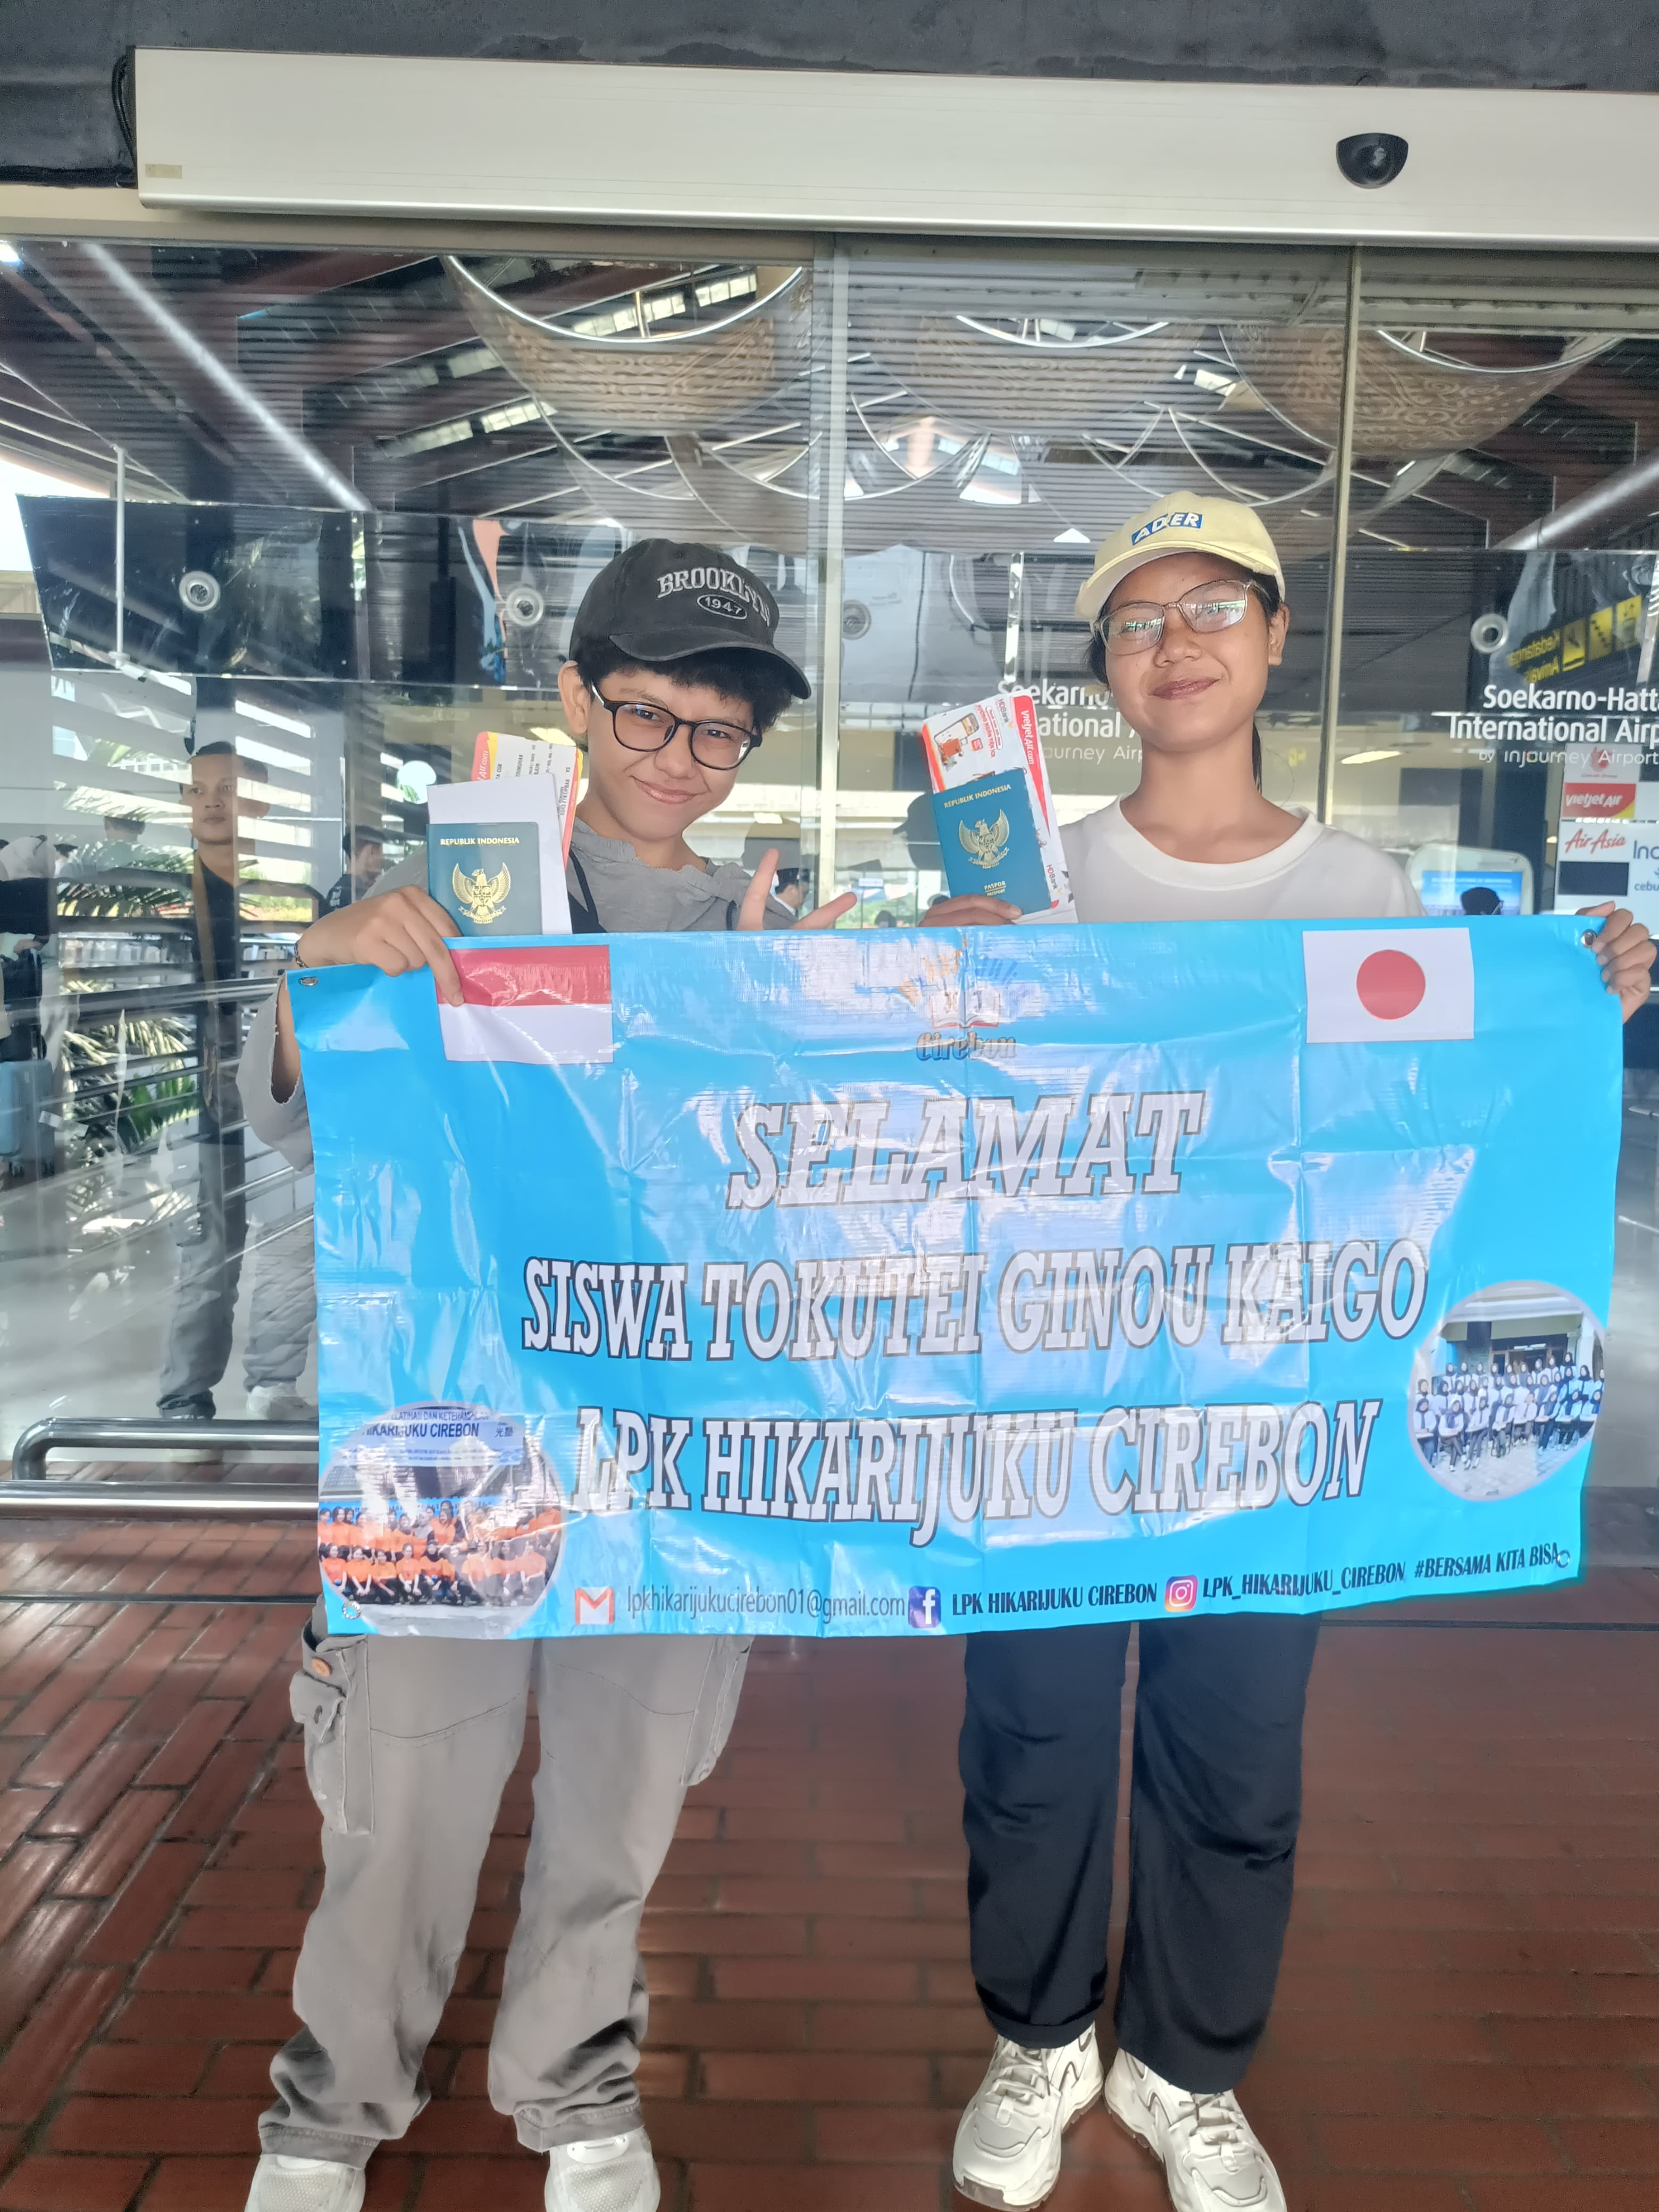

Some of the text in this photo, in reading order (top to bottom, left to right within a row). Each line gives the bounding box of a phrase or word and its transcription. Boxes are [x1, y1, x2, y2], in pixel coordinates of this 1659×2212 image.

[1133, 512, 1200, 544] ADER
[657, 567, 770, 627] BROOKLYN
[705, 596, 743, 615] 1947
[997, 699, 1010, 723] HDBank
[1482, 683, 1659, 711] Soekarno-Hatt
[1449, 715, 1607, 743] International
[1479, 750, 1495, 763] by
[1504, 749, 1591, 768] injourney
[944, 784, 1011, 809] REPUBLIK INDONESIA
[984, 880, 1006, 891] PASPOR
[1046, 864, 1059, 891] HDBank
[916, 1030, 1017, 1062] Cirebon
[724, 1090, 1207, 1210] SELAMAT
[522, 1238, 1429, 1362] SISWA TOKUTEI GINOU KAIGO
[430, 1422, 480, 1437] CIREBON
[569, 1398, 1383, 1548] LPK HIKARIJUKU CIREBON
[1202, 1541, 1559, 1600] LPK_HIKARIJUKU_CIREBON #BERSAMA KITA BISA
[627, 1585, 905, 1624] lpkhikarijukucirebon01@gmail.com
[952, 1582, 1158, 1616] LPK HIKARIJUKU CIREBON
